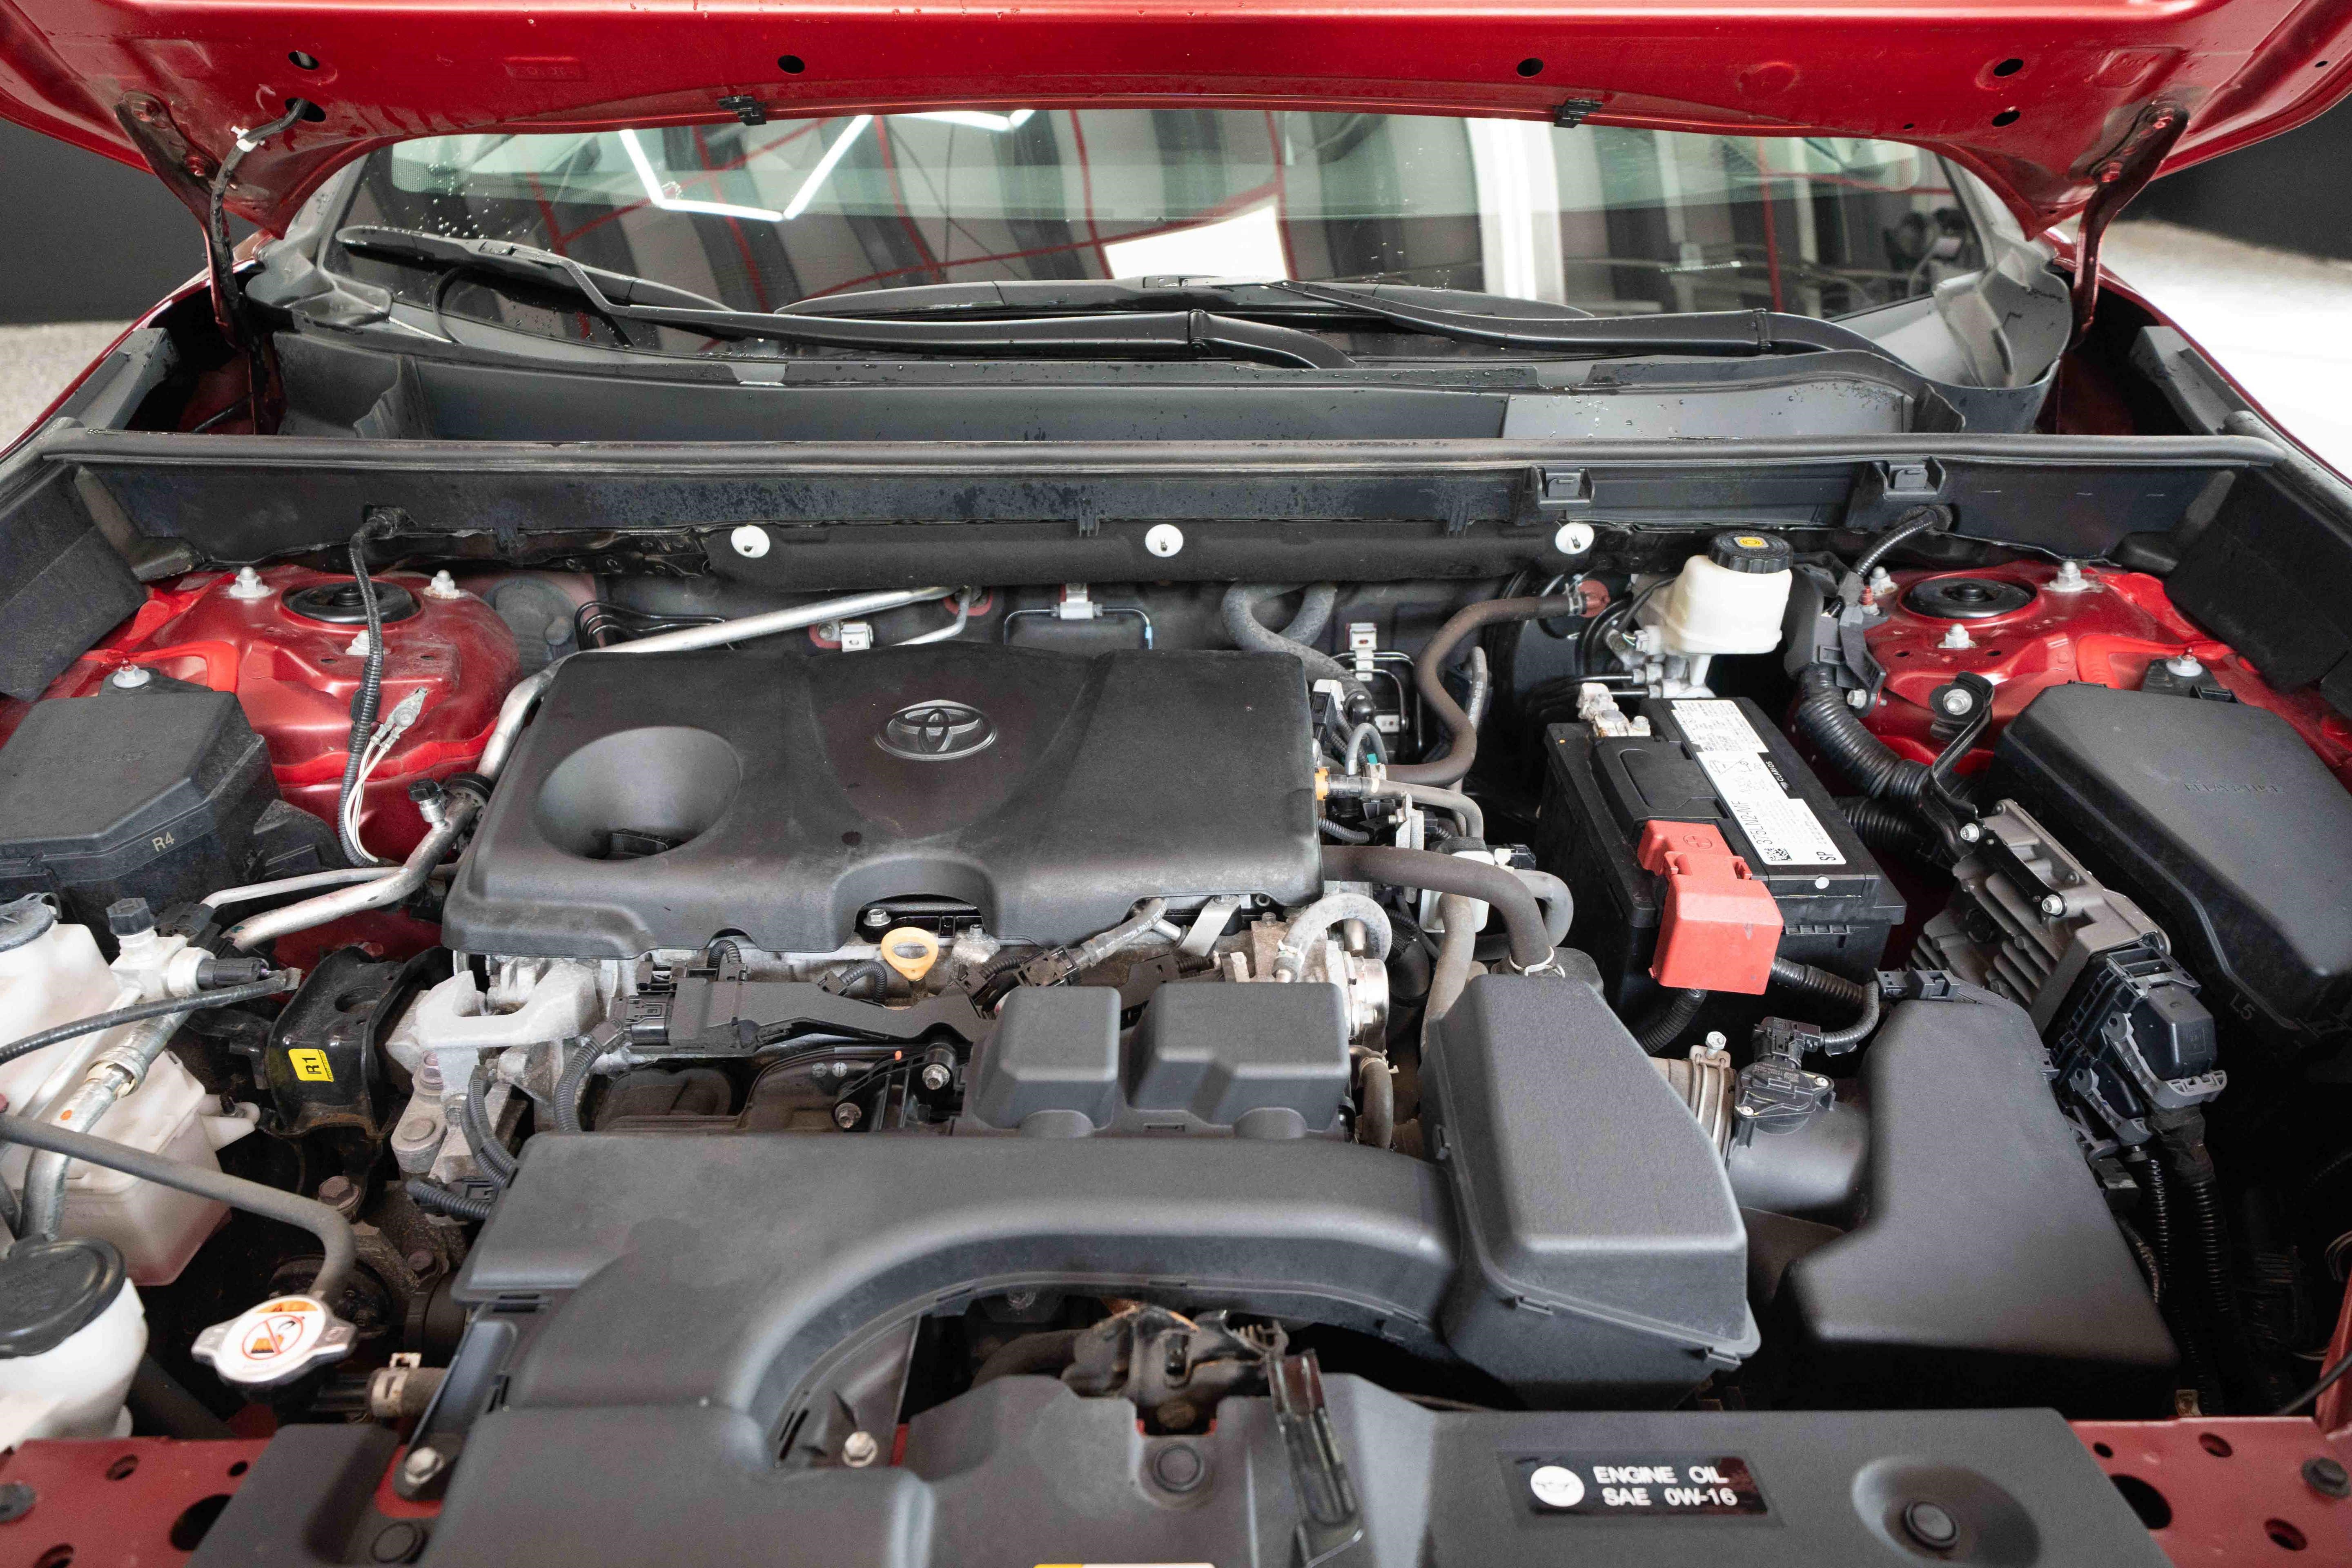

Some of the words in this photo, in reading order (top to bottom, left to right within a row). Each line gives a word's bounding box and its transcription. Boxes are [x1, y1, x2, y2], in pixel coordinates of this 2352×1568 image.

[1765, 761, 1784, 782] CLARIOS
[1731, 800, 1773, 845] 375LN2-MF
[152, 831, 174, 852] R4
[1816, 851, 1836, 861] SP
[2230, 993, 2256, 1020] L5
[301, 1057, 323, 1074] R1
[1592, 1466, 1678, 1484] ENGINE
[1688, 1466, 1730, 1484] OIL
[1602, 1487, 1653, 1506] SAE
[1664, 1487, 1738, 1506] 0W-16
